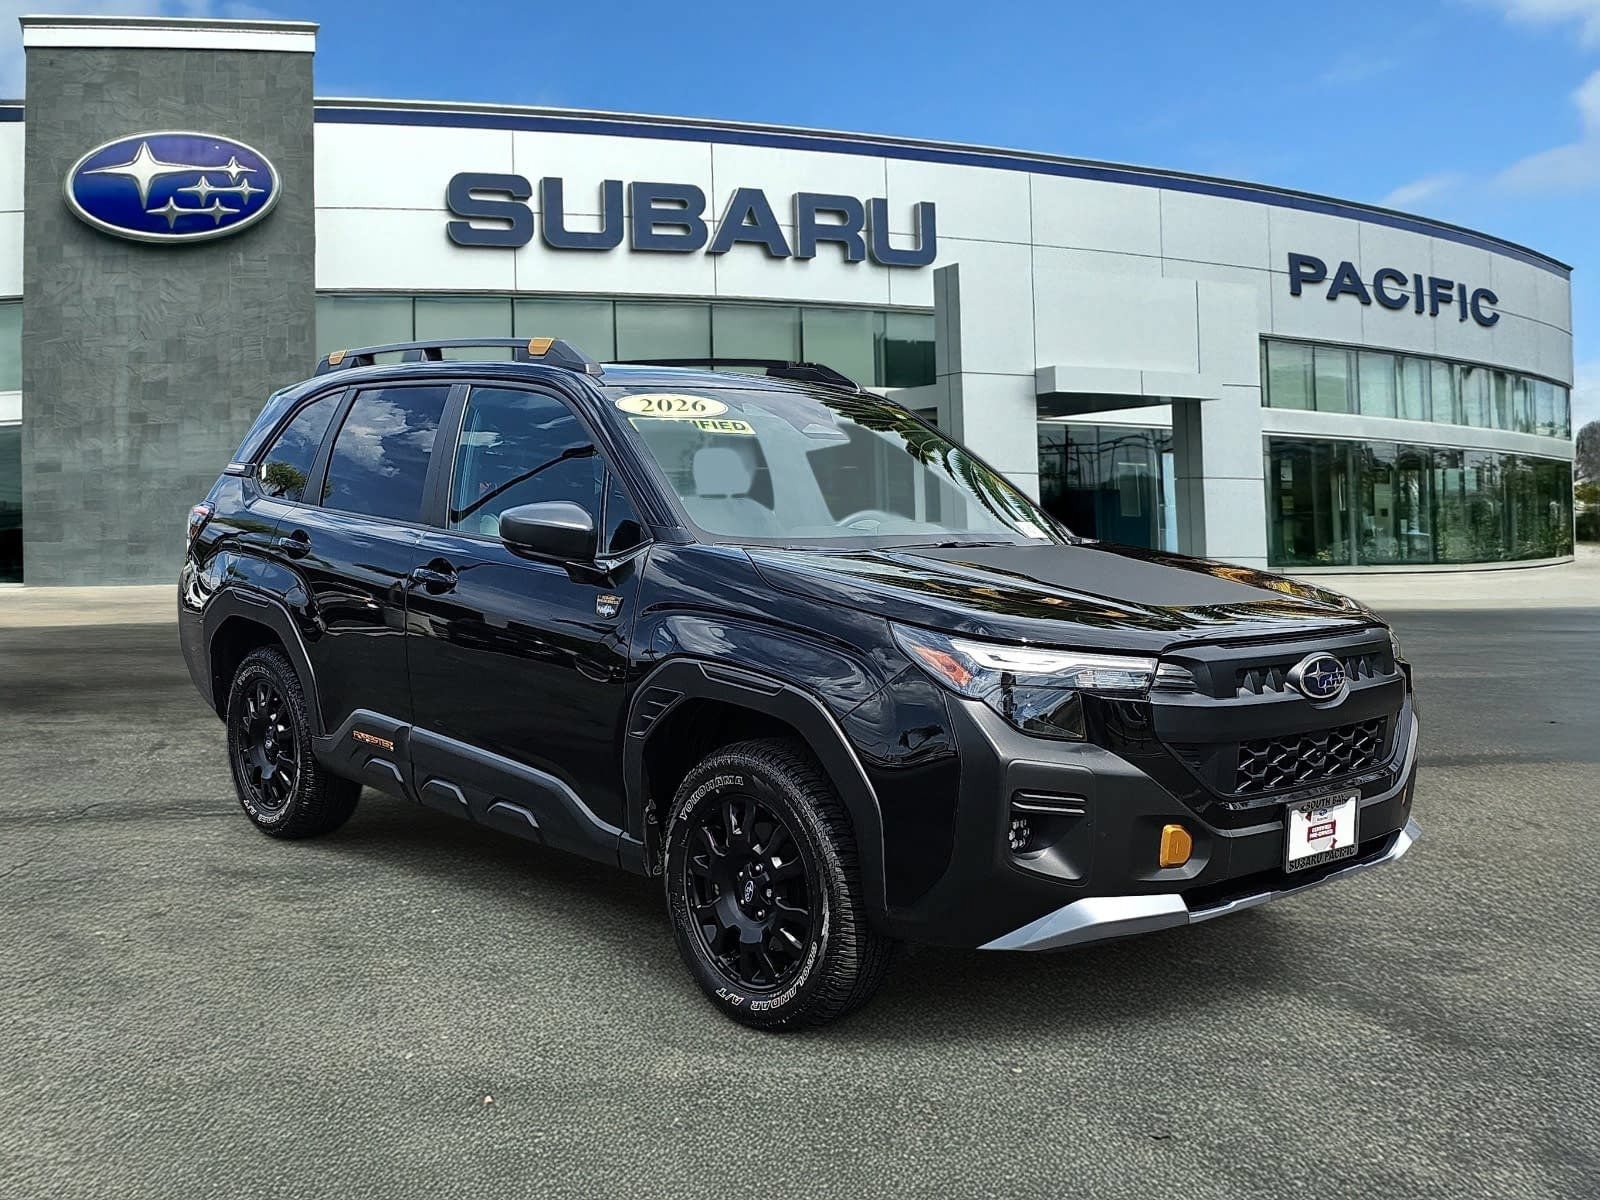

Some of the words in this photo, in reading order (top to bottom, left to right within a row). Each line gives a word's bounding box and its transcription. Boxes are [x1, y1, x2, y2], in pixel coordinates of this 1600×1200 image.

[446, 172, 937, 267] SUBARU
[1288, 252, 1500, 327] PACIFIC
[640, 398, 706, 412] 2026
[679, 775, 744, 821] YOKOHAMA
[1306, 797, 1331, 810] SOUTH
[1288, 853, 1323, 872] SUBARU
[715, 987, 745, 1006] A/T
